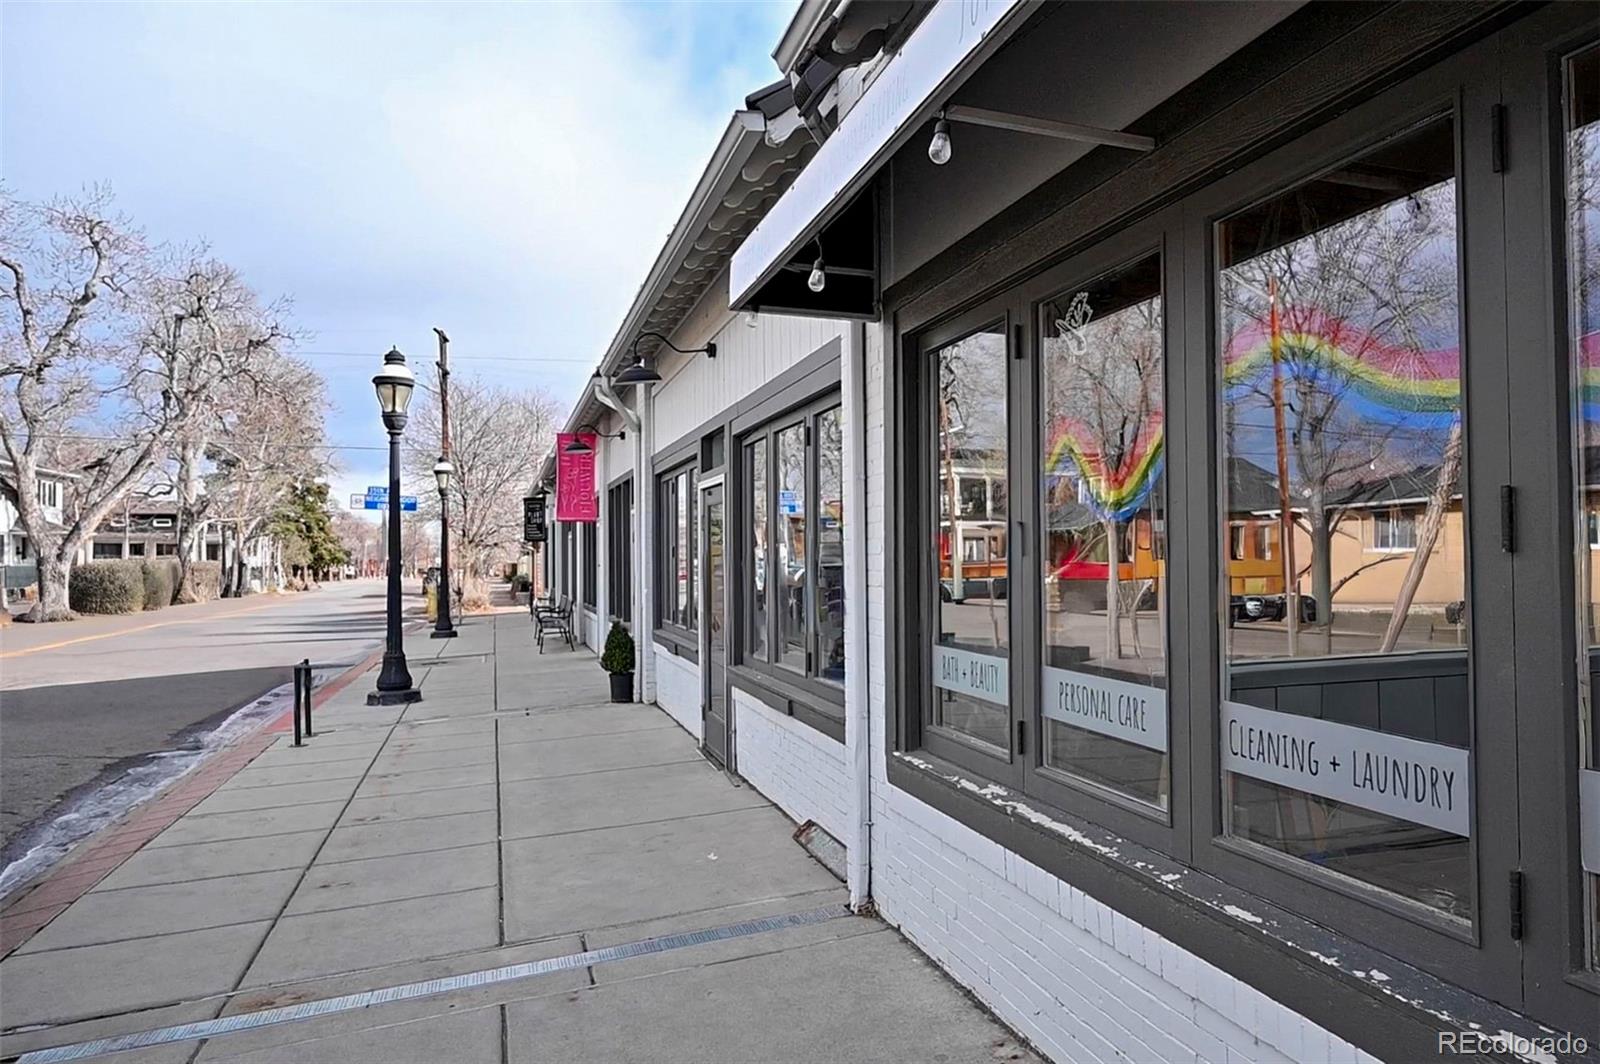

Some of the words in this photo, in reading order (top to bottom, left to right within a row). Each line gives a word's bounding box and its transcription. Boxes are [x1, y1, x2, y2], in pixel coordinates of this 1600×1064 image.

[942, 655, 959, 684] BATH
[962, 671, 967, 680] +
[970, 660, 999, 693] BEAUTY
[1058, 681, 1114, 723] PERSONAL
[1118, 694, 1147, 732] CARE
[1228, 719, 1320, 777] CLEANING
[1329, 755, 1341, 773] +
[1352, 750, 1455, 812] LAUNDRY
